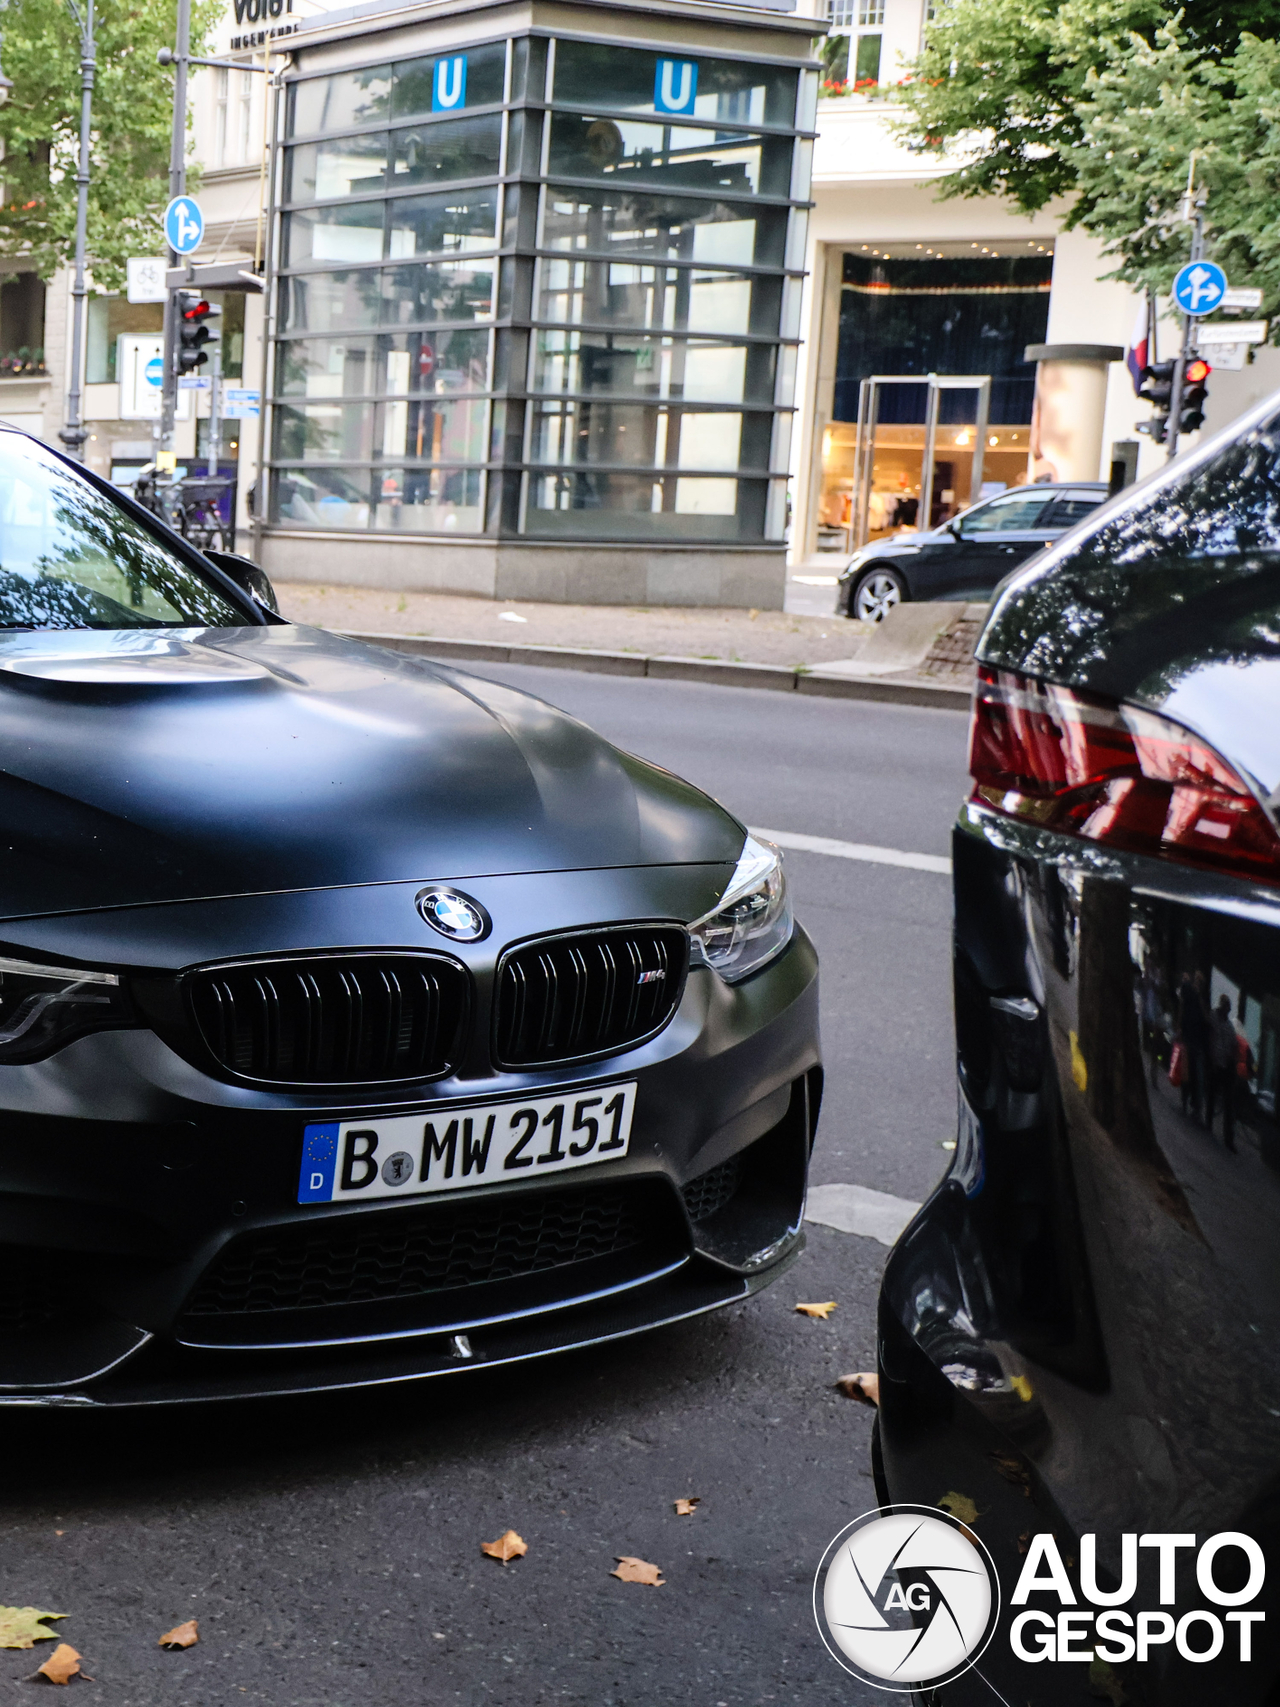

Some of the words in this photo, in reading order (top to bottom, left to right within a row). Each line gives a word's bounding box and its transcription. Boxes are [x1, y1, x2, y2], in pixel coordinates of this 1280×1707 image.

[437, 57, 463, 108] U
[661, 60, 692, 111] U
[340, 1129, 379, 1191] B
[419, 1114, 496, 1182] MW
[504, 1092, 626, 1171] 2151
[310, 1173, 324, 1190] D
